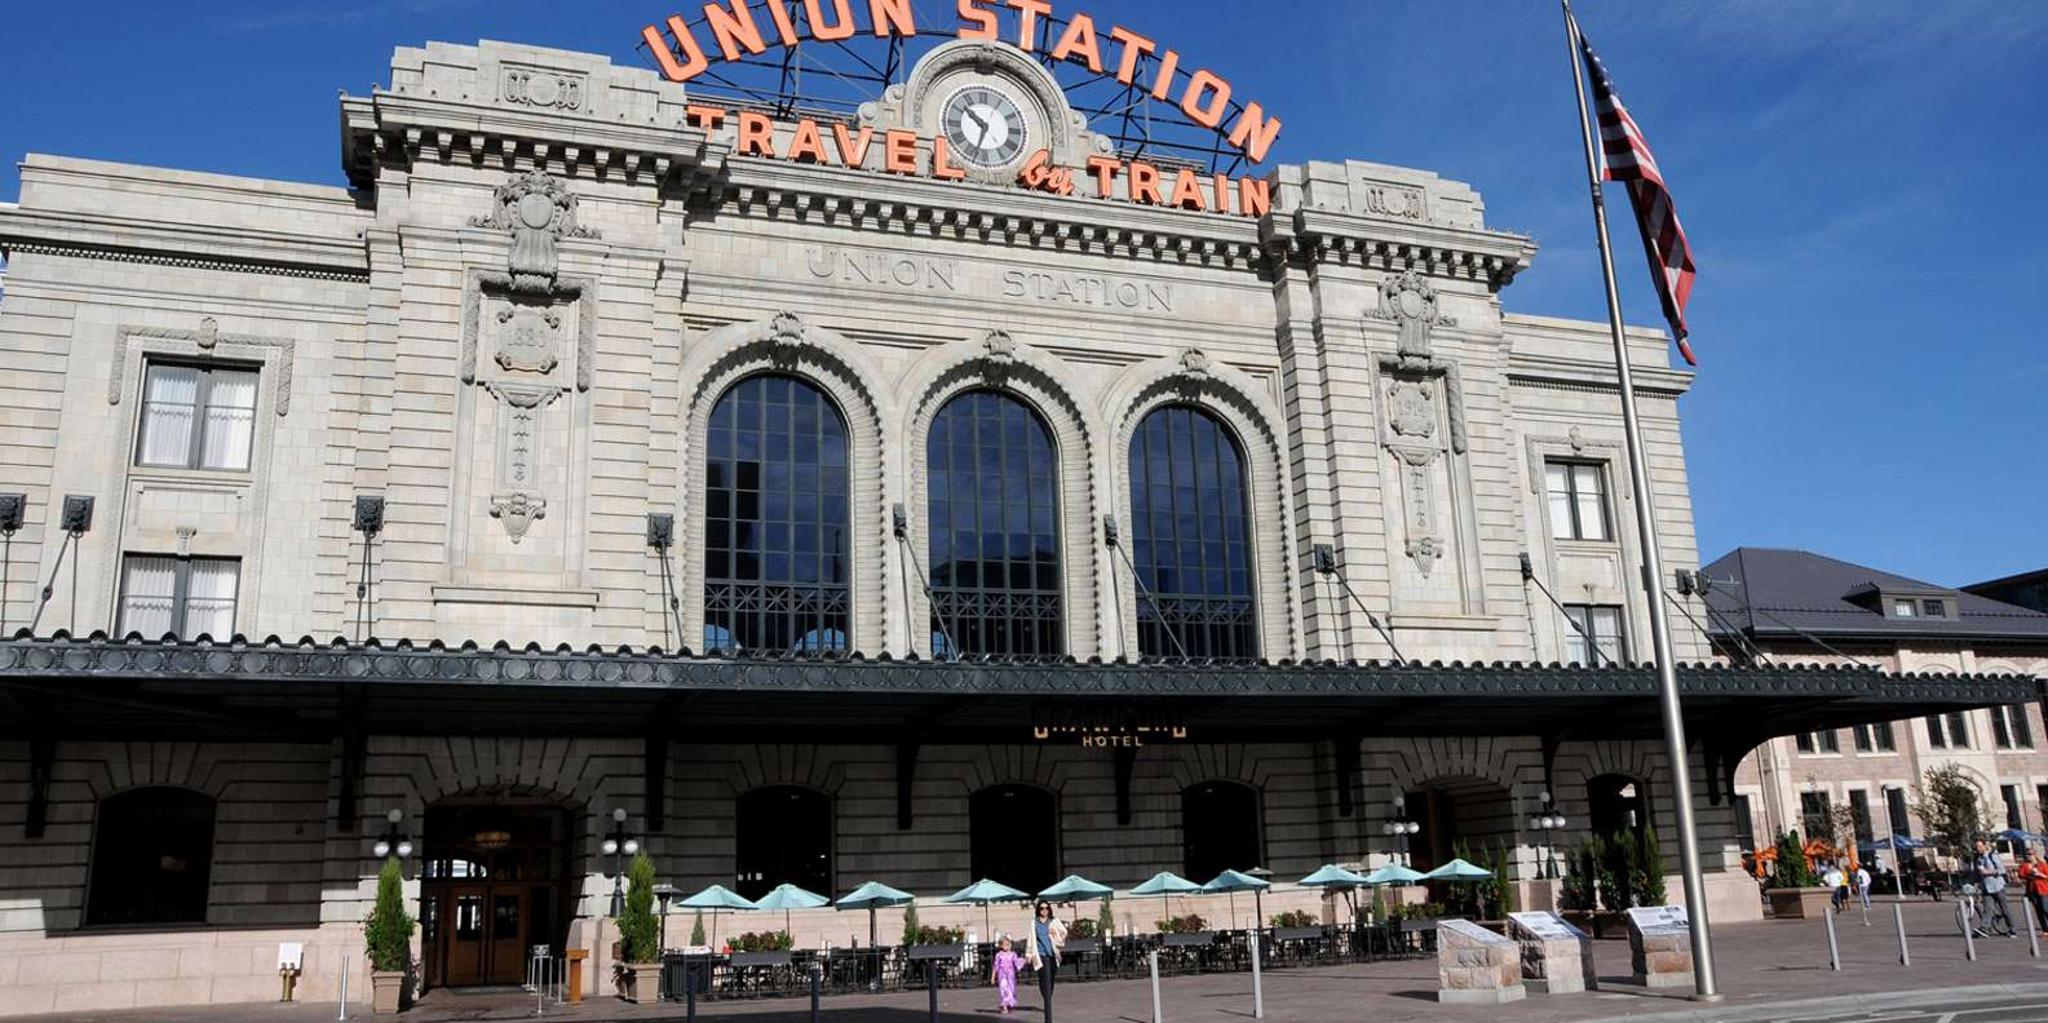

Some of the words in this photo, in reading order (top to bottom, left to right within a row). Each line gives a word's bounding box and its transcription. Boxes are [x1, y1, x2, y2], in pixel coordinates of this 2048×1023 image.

[641, 0, 916, 82] UNION
[957, 0, 1282, 165] STATION
[687, 104, 966, 180] TRAVEL
[1018, 149, 1075, 196] by
[1087, 155, 1271, 217] TRAIN
[806, 249, 956, 291] UNION
[1003, 270, 1173, 313] STATION
[1083, 735, 1143, 747] HOTEL
